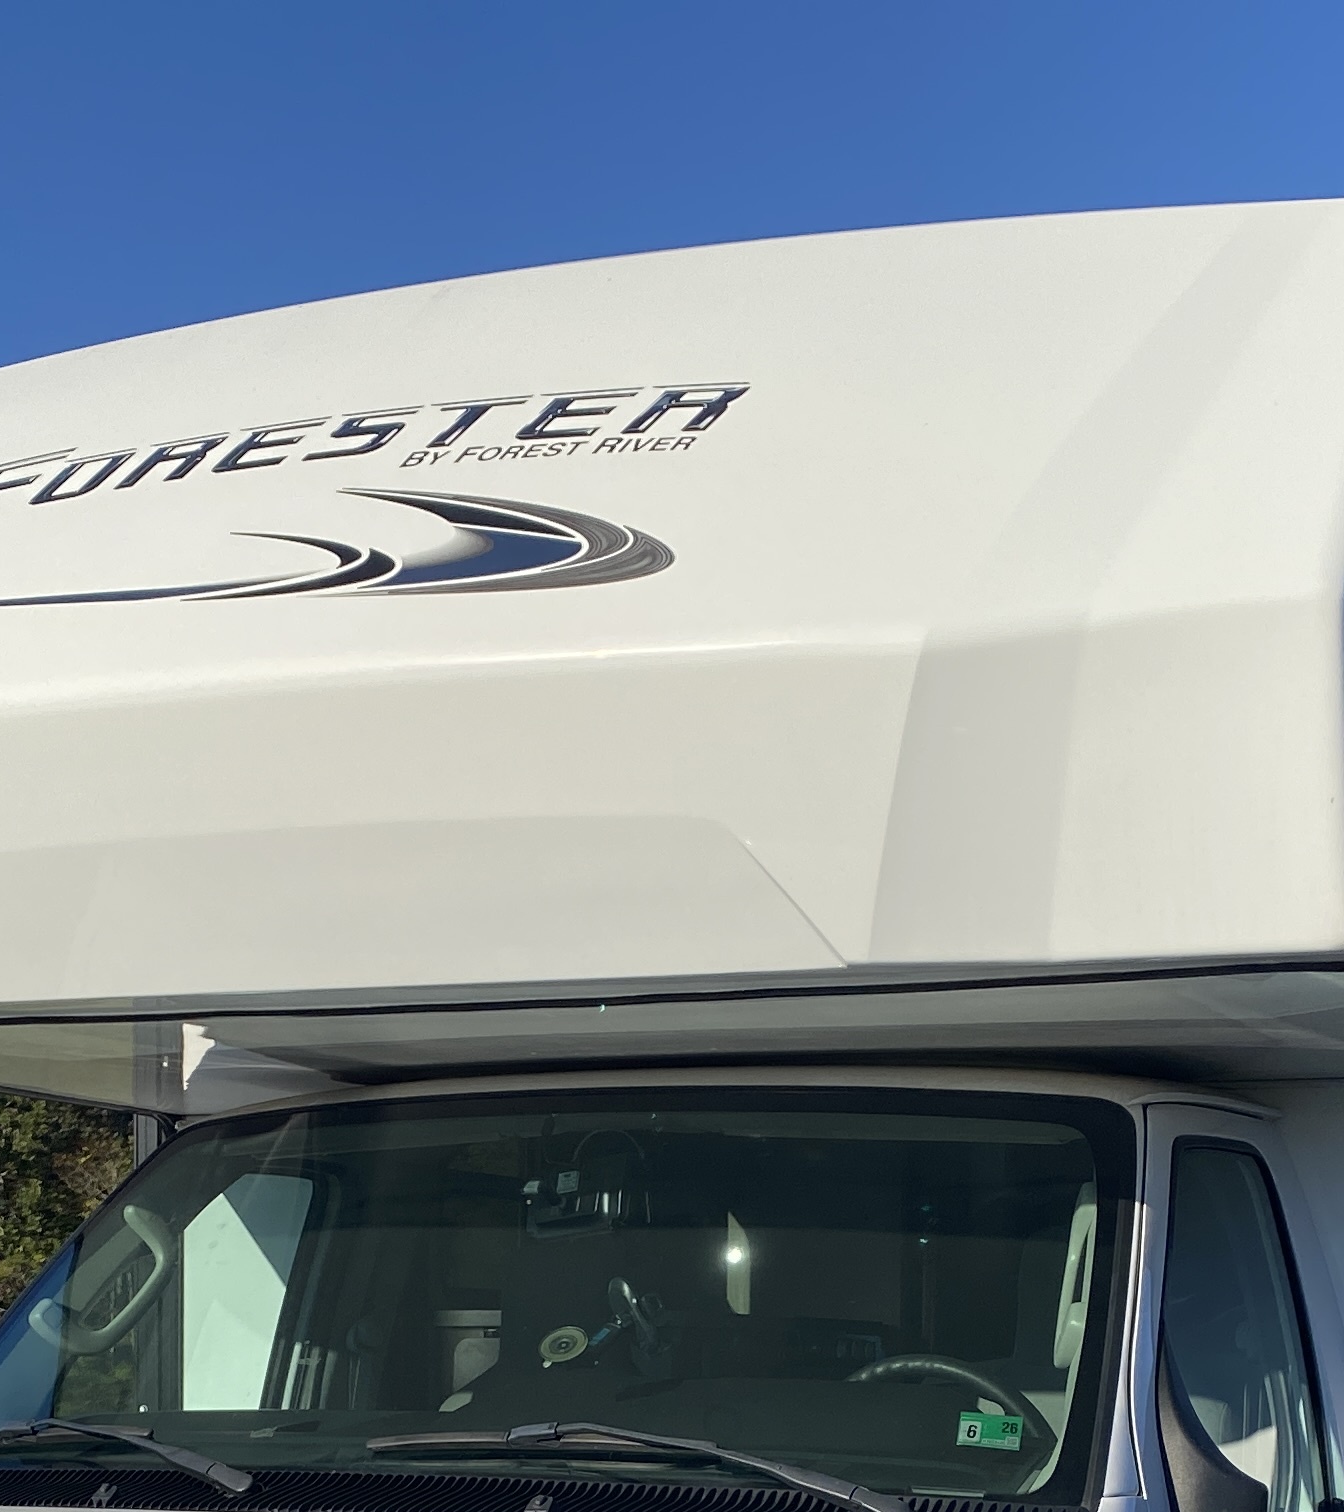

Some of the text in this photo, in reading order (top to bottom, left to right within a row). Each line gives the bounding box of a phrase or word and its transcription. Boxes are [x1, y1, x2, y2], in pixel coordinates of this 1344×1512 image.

[399, 435, 698, 468] BY FOREST RIVER
[966, 1421, 1018, 1438] 6 26
